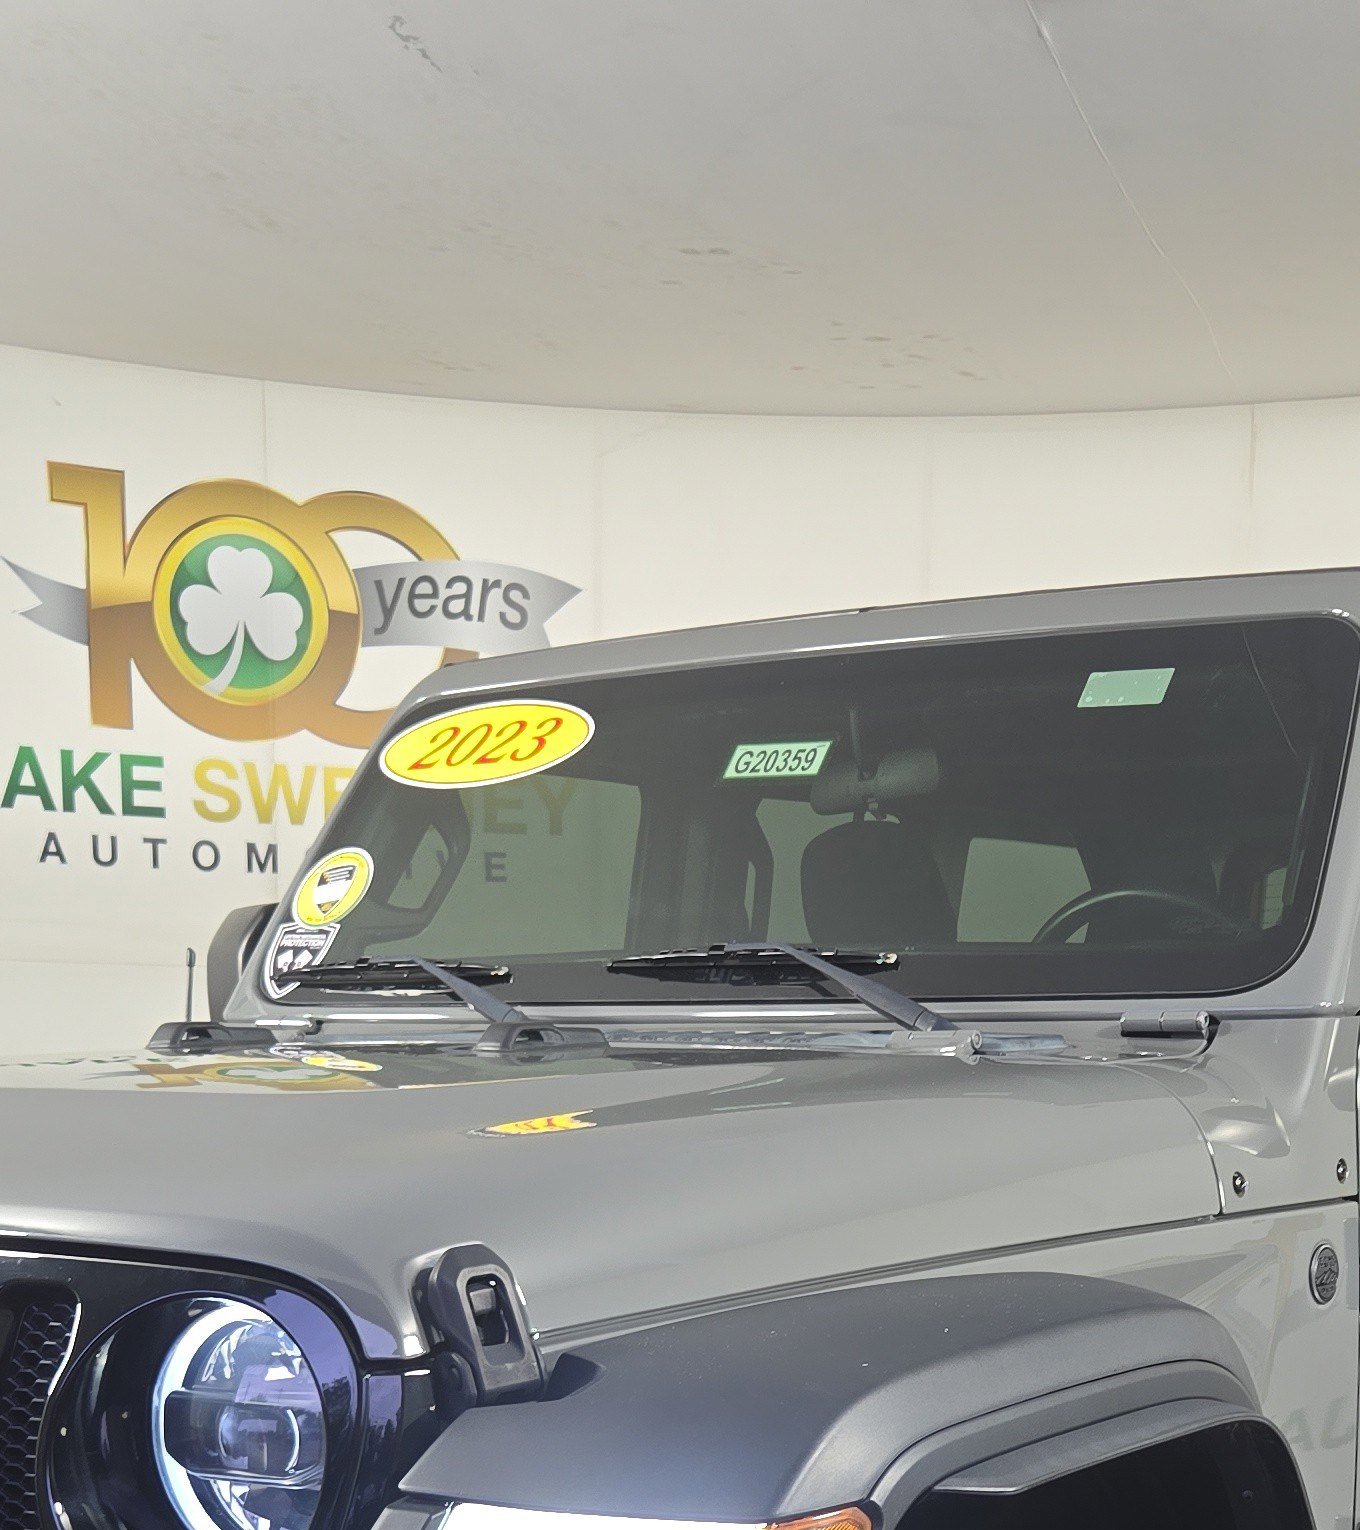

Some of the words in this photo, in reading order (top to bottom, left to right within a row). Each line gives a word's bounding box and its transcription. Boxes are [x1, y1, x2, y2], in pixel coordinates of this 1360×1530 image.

[47, 460, 479, 749] 100
[374, 575, 530, 634] years
[408, 717, 563, 770] 2023
[735, 748, 817, 774] G20359
